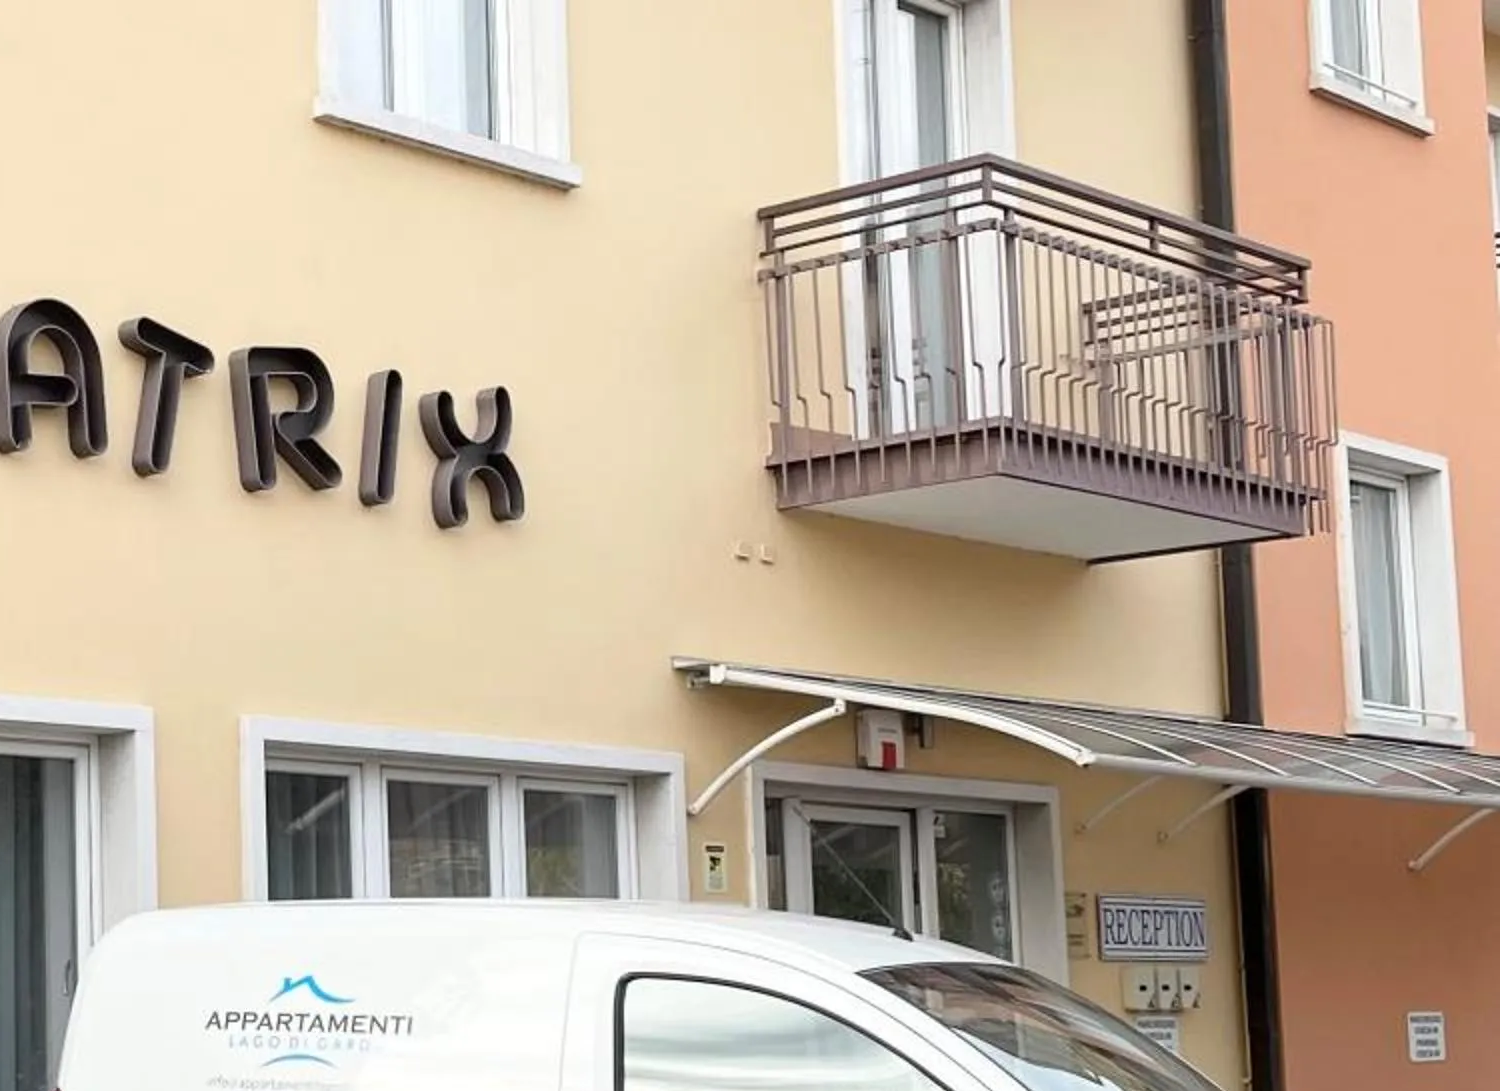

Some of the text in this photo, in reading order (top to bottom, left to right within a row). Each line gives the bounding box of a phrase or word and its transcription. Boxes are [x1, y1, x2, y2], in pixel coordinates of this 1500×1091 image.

[1103, 907, 1206, 947] RECEPTION
[205, 1011, 414, 1035] APPARTAMENTI
[229, 1035, 281, 1050] LAGO
